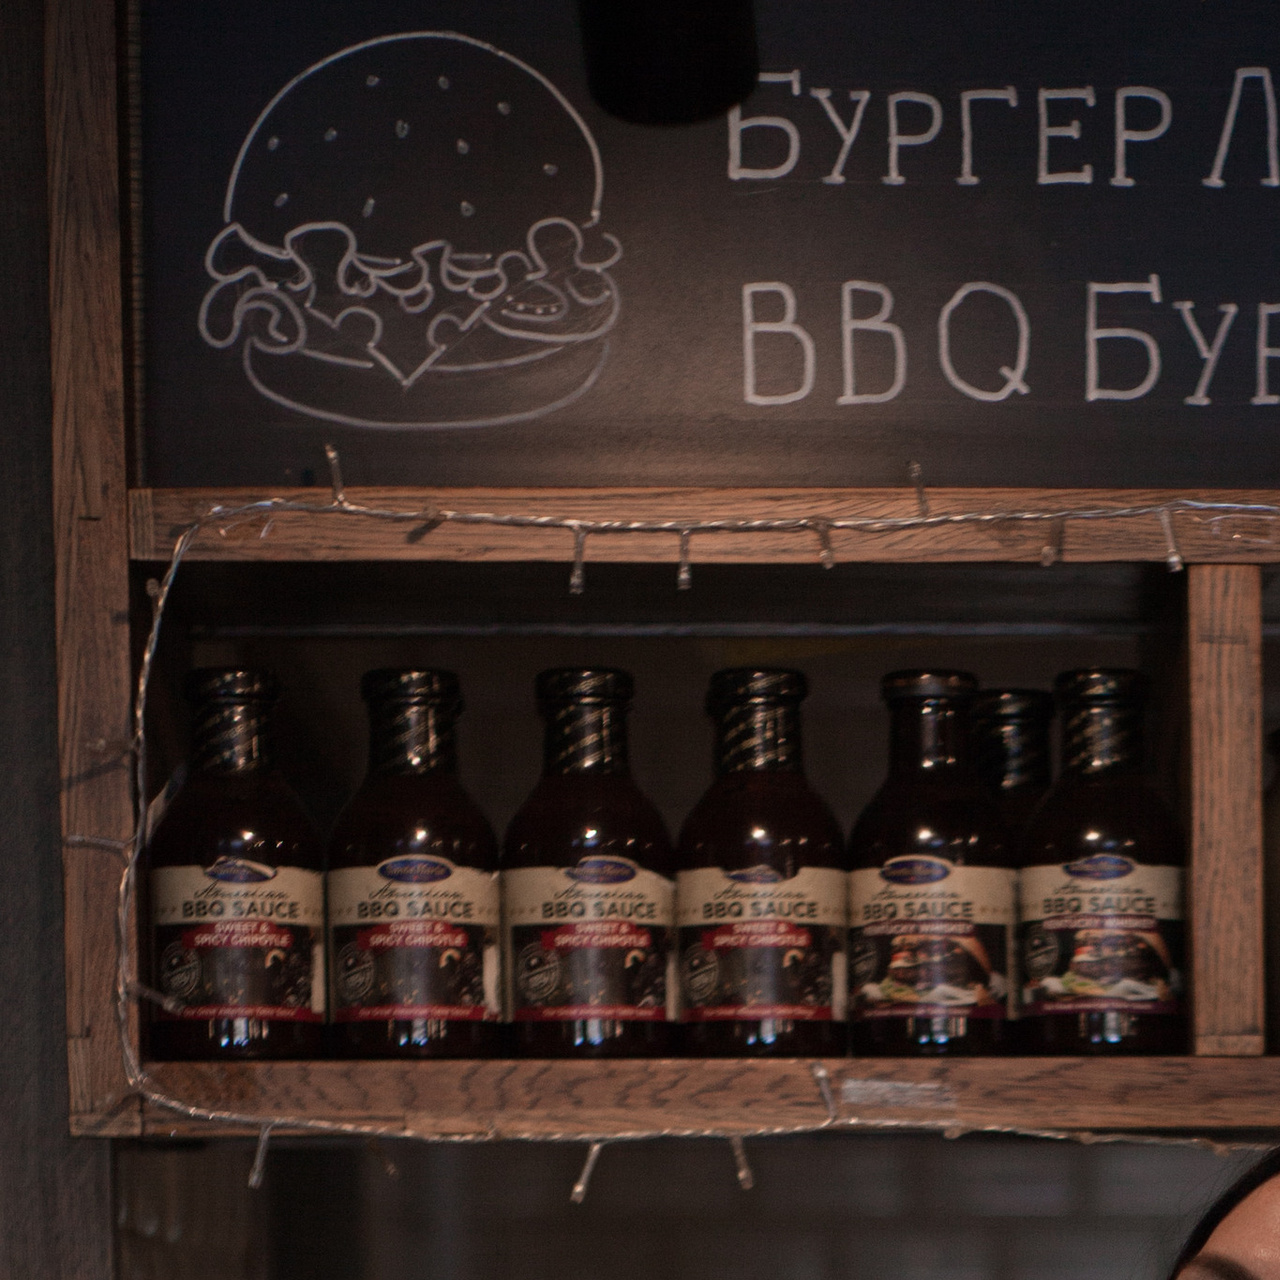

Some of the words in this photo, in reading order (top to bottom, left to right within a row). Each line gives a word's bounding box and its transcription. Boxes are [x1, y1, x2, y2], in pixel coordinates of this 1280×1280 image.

[728, 71, 1173, 185] БУРГЕР
[741, 280, 1030, 404] BBQ
[182, 902, 224, 920] BBQ
[233, 902, 299, 919] SAUCE
[358, 902, 401, 920] BBQ
[408, 902, 474, 919] SAUCE
[542, 902, 584, 920] BBQ
[592, 902, 658, 919] SAUCE
[703, 902, 743, 920] BBQ
[750, 902, 817, 918] SAUCE
[863, 903, 899, 920] BBQ
[904, 901, 973, 919] SAUCE
[1043, 897, 1081, 915] BBQ
[1087, 896, 1156, 914] SAUCE
